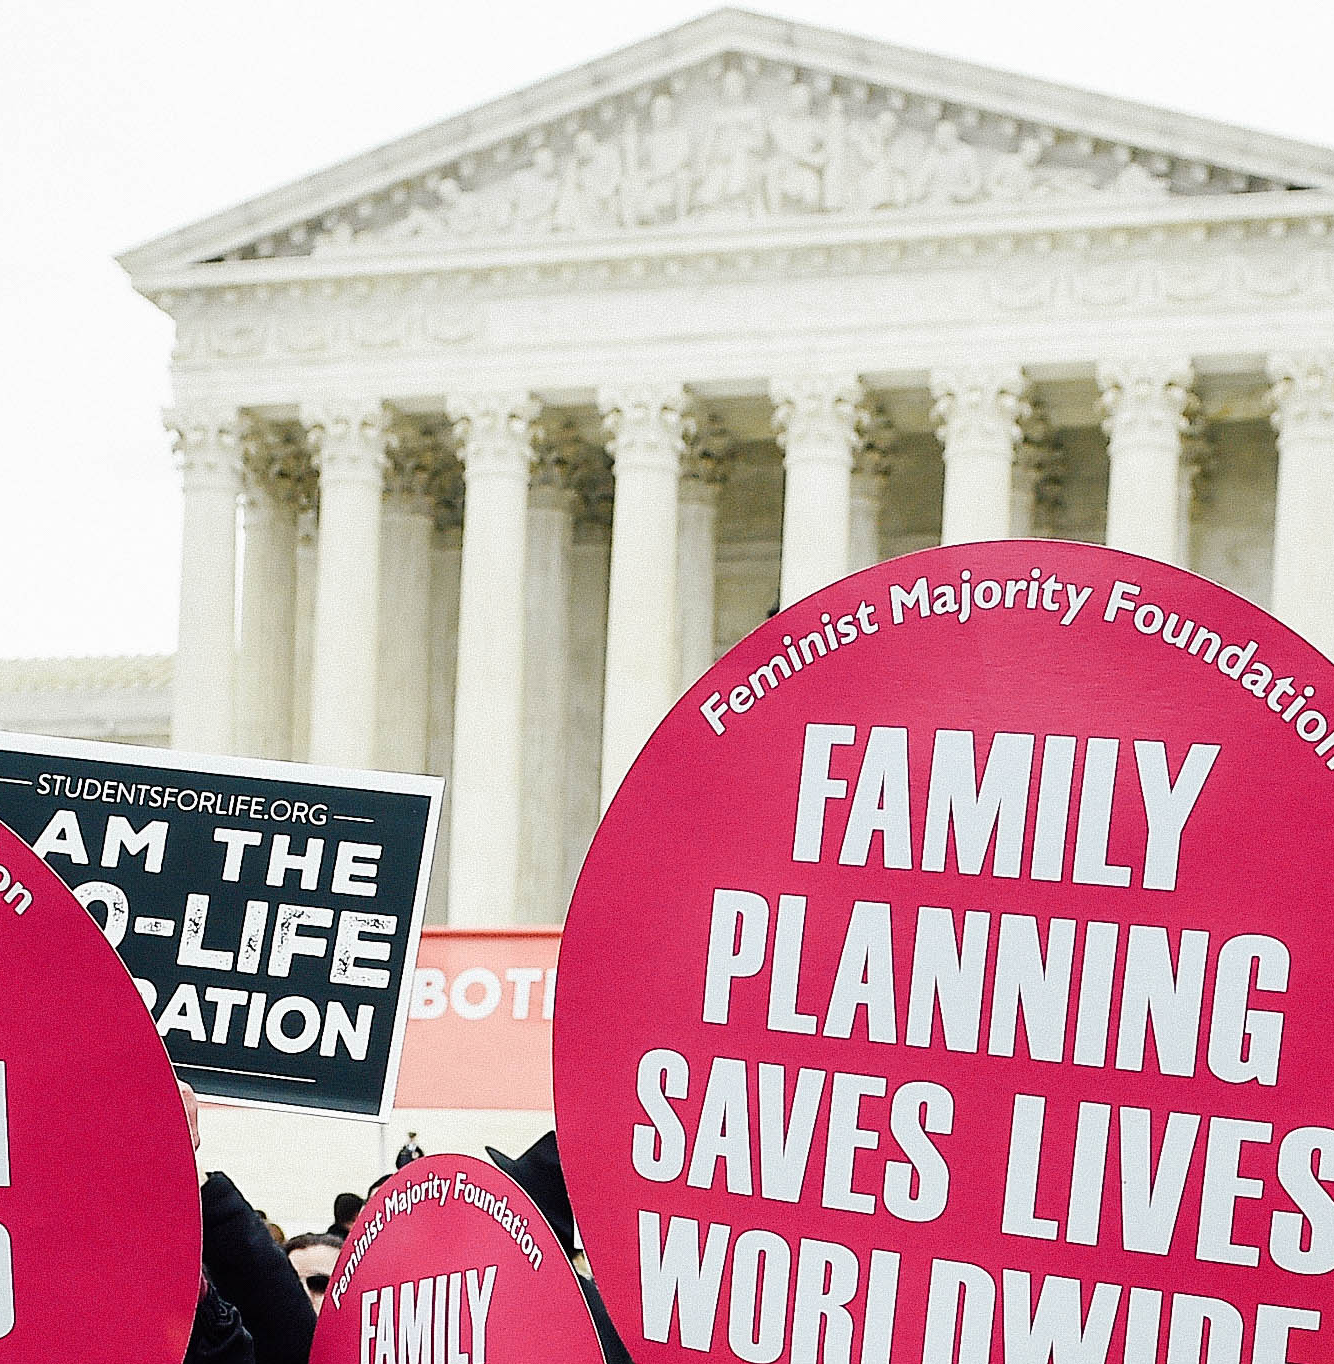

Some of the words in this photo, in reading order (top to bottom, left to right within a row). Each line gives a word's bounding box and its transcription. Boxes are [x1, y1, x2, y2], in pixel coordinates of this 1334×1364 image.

[700, 602, 878, 735] Feminist
[890, 569, 1092, 625] Majority
[29, 810, 169, 873] AM
[214, 828, 382, 896] THE
[36, 773, 328, 827] STUDENTSFORLIFE.ORG
[793, 724, 1220, 890] FAMILY
[409, 966, 555, 1021] BOT
[703, 889, 1289, 1086] PLANNING
[633, 1049, 953, 1222] SAVES
[332, 1213, 383, 1309] Feminist
[385, 1175, 448, 1221] Majority
[454, 1173, 542, 1270] Foundation
